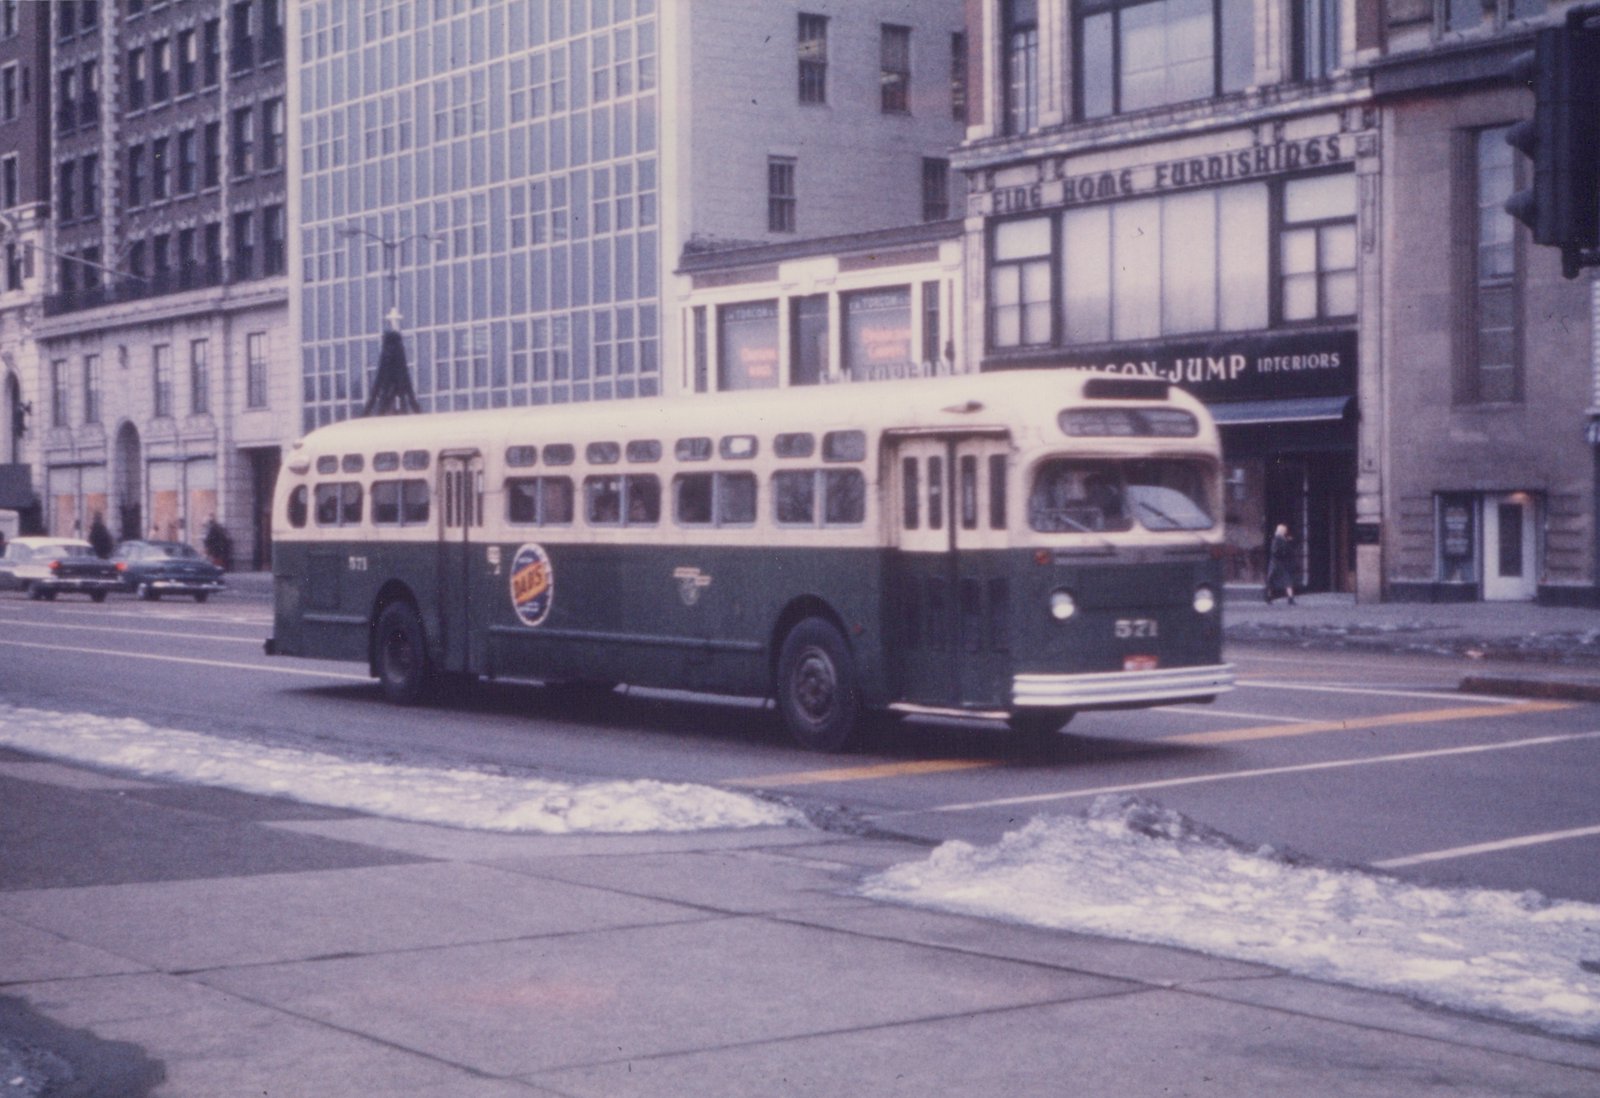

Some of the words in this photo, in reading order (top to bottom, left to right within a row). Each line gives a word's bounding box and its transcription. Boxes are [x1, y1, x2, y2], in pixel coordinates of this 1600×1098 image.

[992, 184, 1042, 215] FINE
[1063, 169, 1133, 203] HOME
[1155, 136, 1340, 188] FURNISHINGS
[1257, 353, 1340, 373] INTERIORS
[1114, 620, 1158, 637] 571
